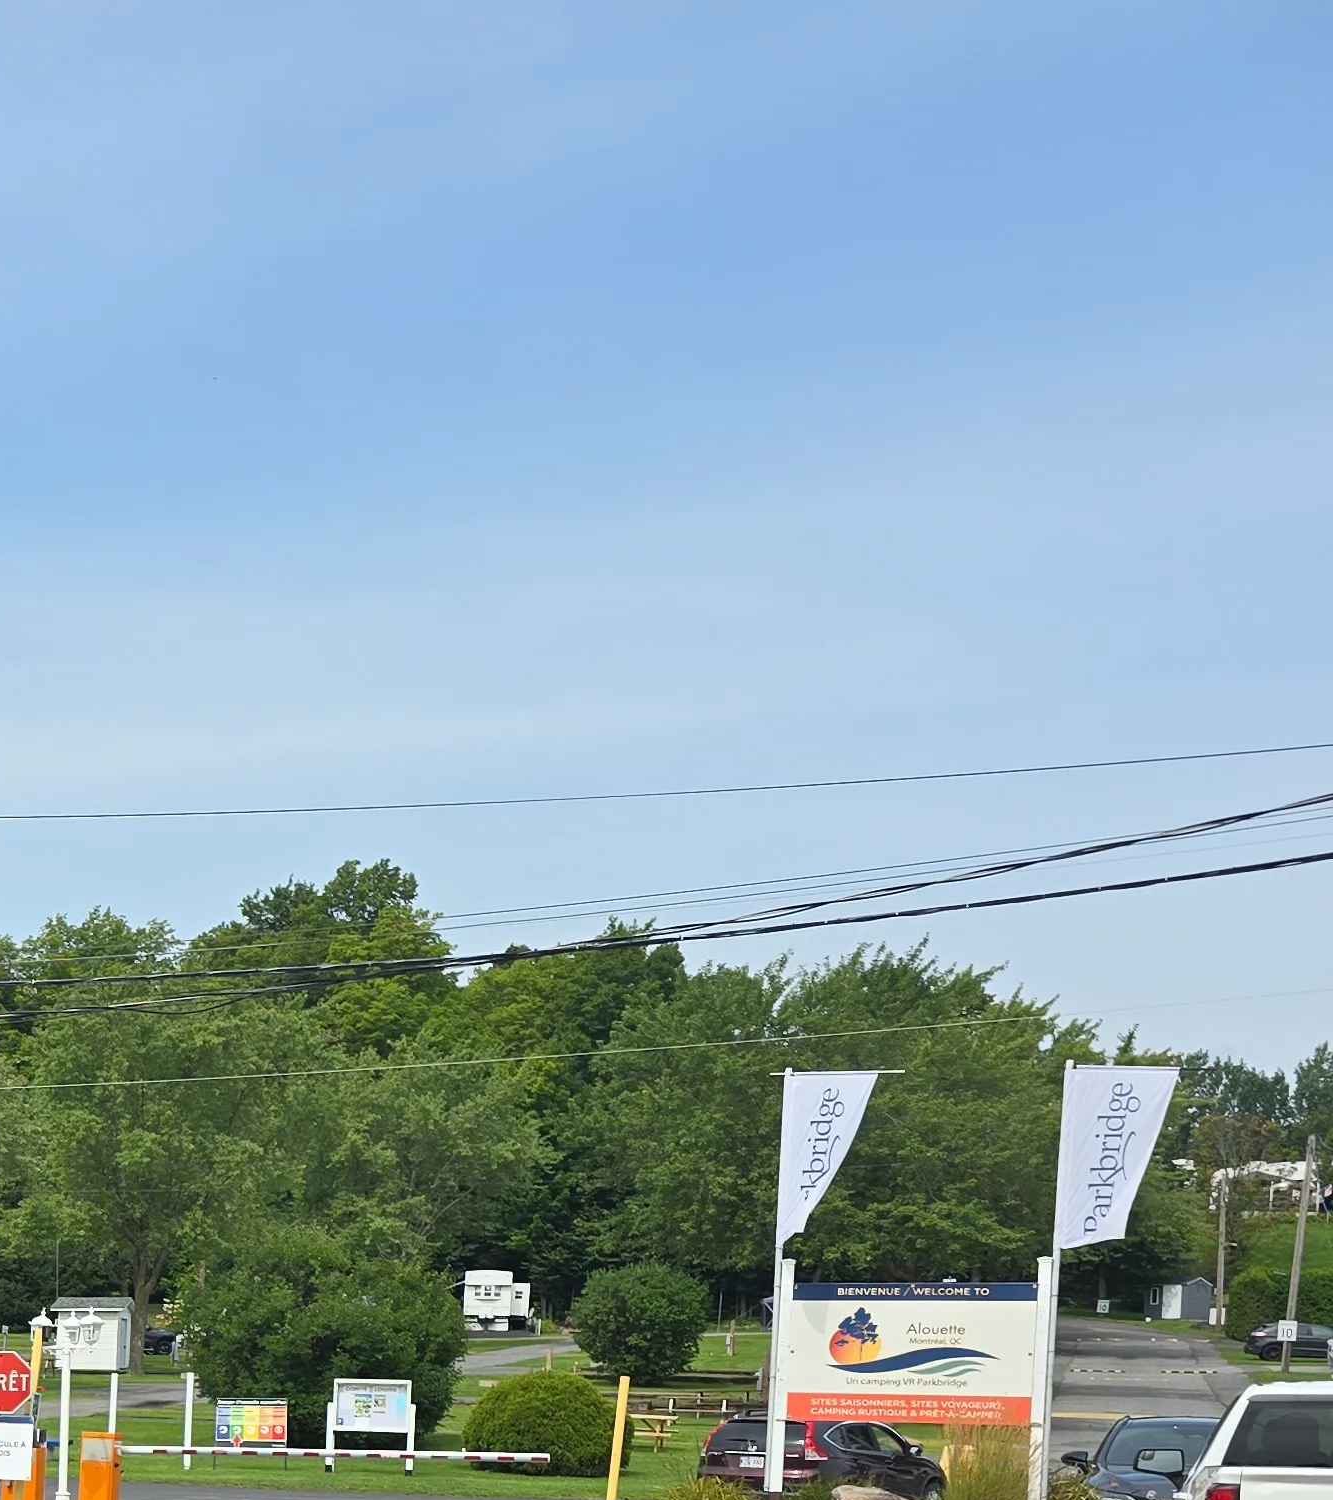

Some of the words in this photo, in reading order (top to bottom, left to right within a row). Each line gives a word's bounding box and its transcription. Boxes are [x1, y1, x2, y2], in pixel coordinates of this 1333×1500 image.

[800, 1088, 845, 1200] kbridge
[837, 1287, 901, 1296] BIENVENUE
[913, 1287, 970, 1296] WELCOME
[974, 1287, 990, 1296] TO
[1099, 1303, 1107, 1311] 10
[906, 1322, 966, 1335] Alouette
[1282, 1328, 1293, 1339] 10
[909, 1337, 947, 1346] Montréal,
[949, 1337, 962, 1345] QC
[846, 1377, 858, 1385] Un
[860, 1377, 900, 1388] camping
[902, 1378, 915, 1386] VR
[917, 1378, 968, 1388] Parkbridge
[811, 1397, 837, 1406] SITES
[840, 1398, 908, 1408] SAISONNIERS,
[911, 1399, 938, 1408] SITES
[811, 1407, 856, 1416] CAMPING
[858, 1408, 907, 1417] RUSTIQUE
[910, 1409, 917, 1417] &
